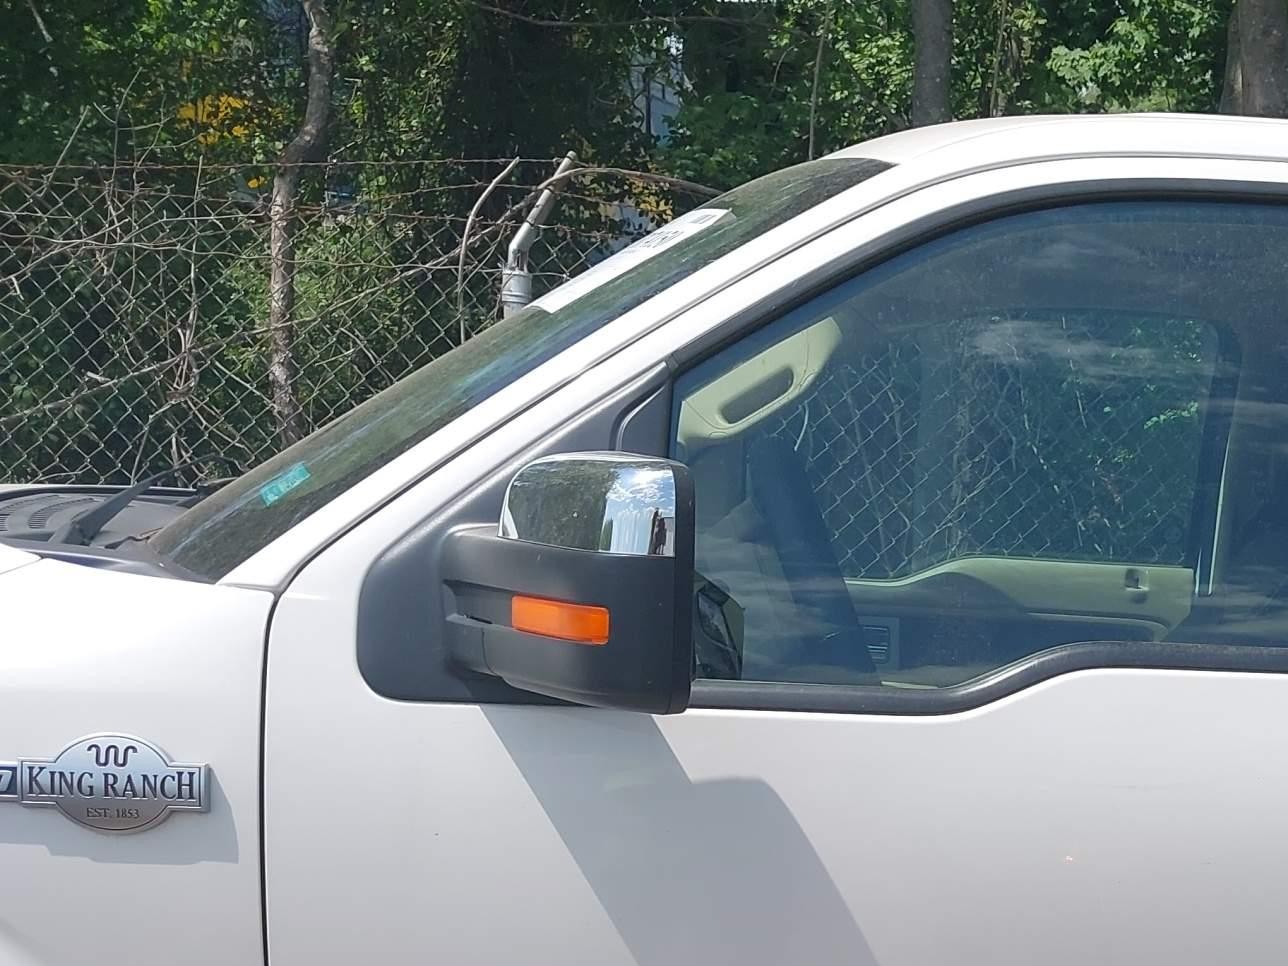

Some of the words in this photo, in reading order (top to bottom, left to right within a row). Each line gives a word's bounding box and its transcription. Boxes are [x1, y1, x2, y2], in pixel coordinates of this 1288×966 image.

[27, 766, 93, 797] KING
[103, 771, 196, 800] RANCH
[115, 807, 140, 819] 1853
